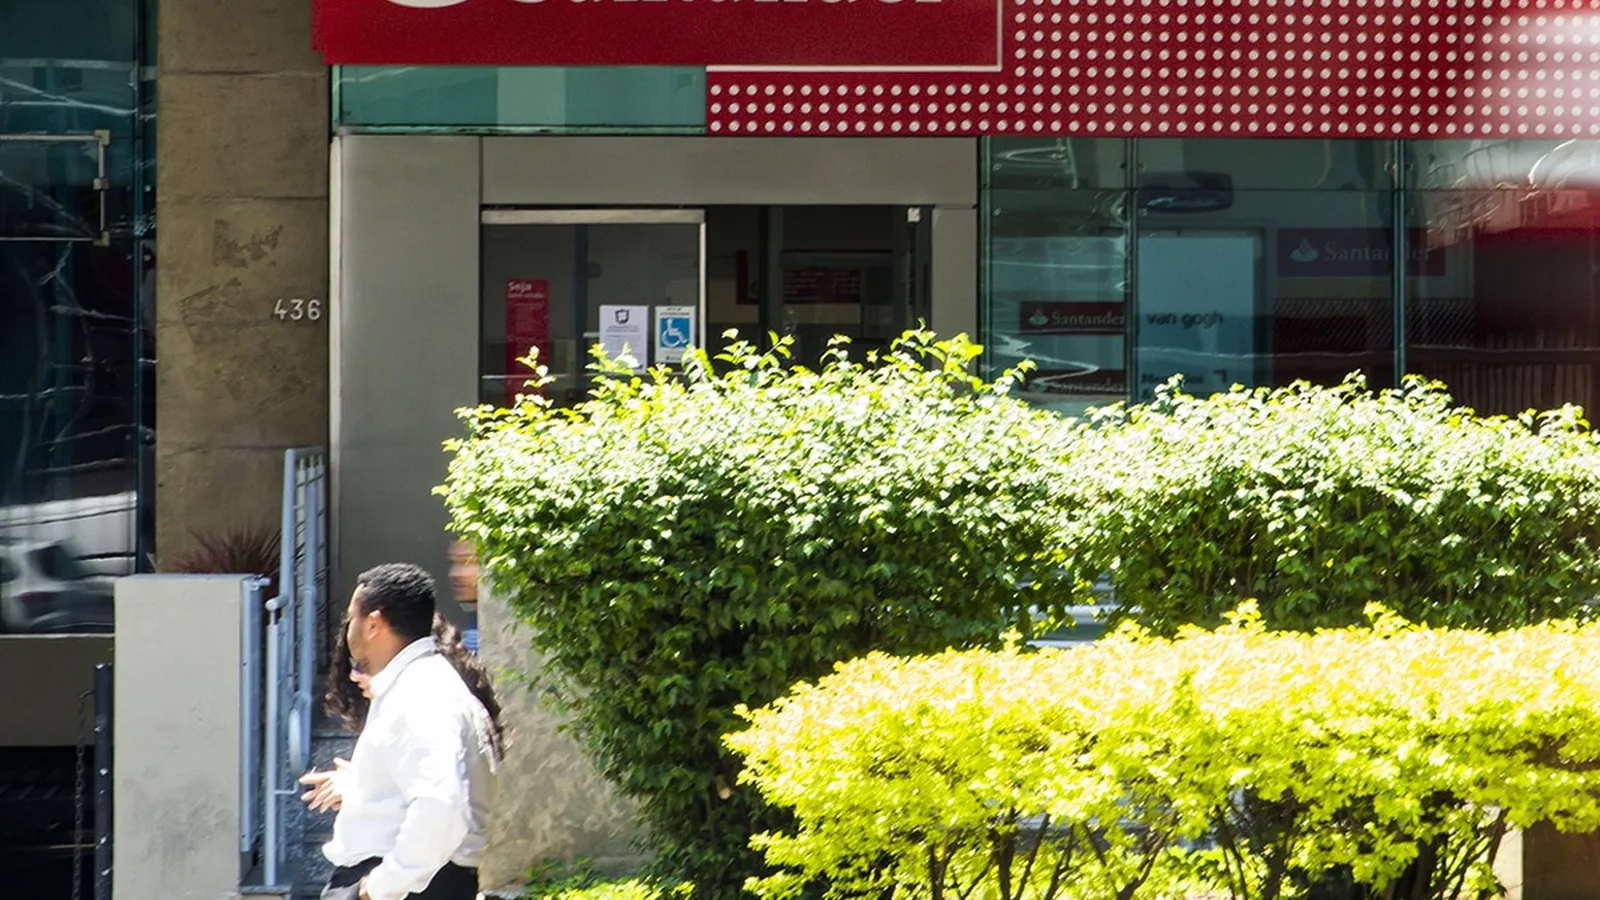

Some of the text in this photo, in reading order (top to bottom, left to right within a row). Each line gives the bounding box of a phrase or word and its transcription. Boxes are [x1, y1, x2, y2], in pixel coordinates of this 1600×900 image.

[1323, 241, 1429, 262] Santaer
[274, 298, 321, 320] 436
[1051, 310, 1125, 326] Santander
[1146, 310, 1224, 329] van gogh
